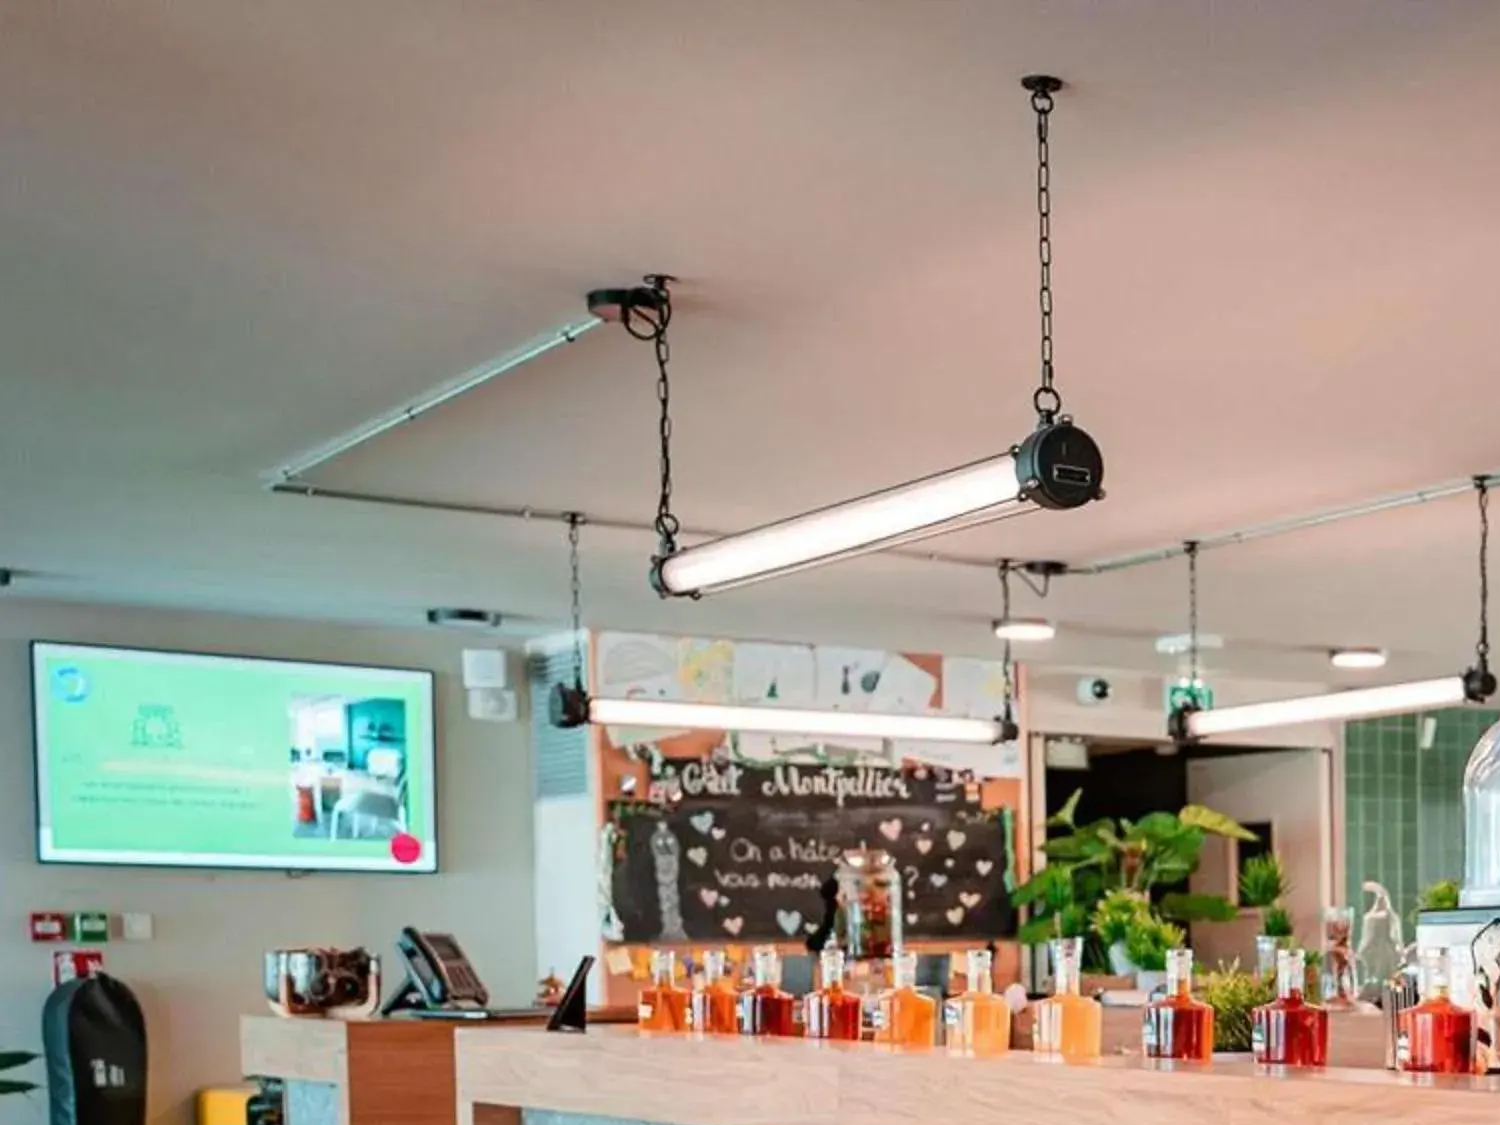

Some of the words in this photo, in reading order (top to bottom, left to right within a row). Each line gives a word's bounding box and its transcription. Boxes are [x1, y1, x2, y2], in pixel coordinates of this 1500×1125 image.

[762, 766, 911, 809] Montpellier
[729, 837, 762, 863] On
[770, 847, 786, 863] a
